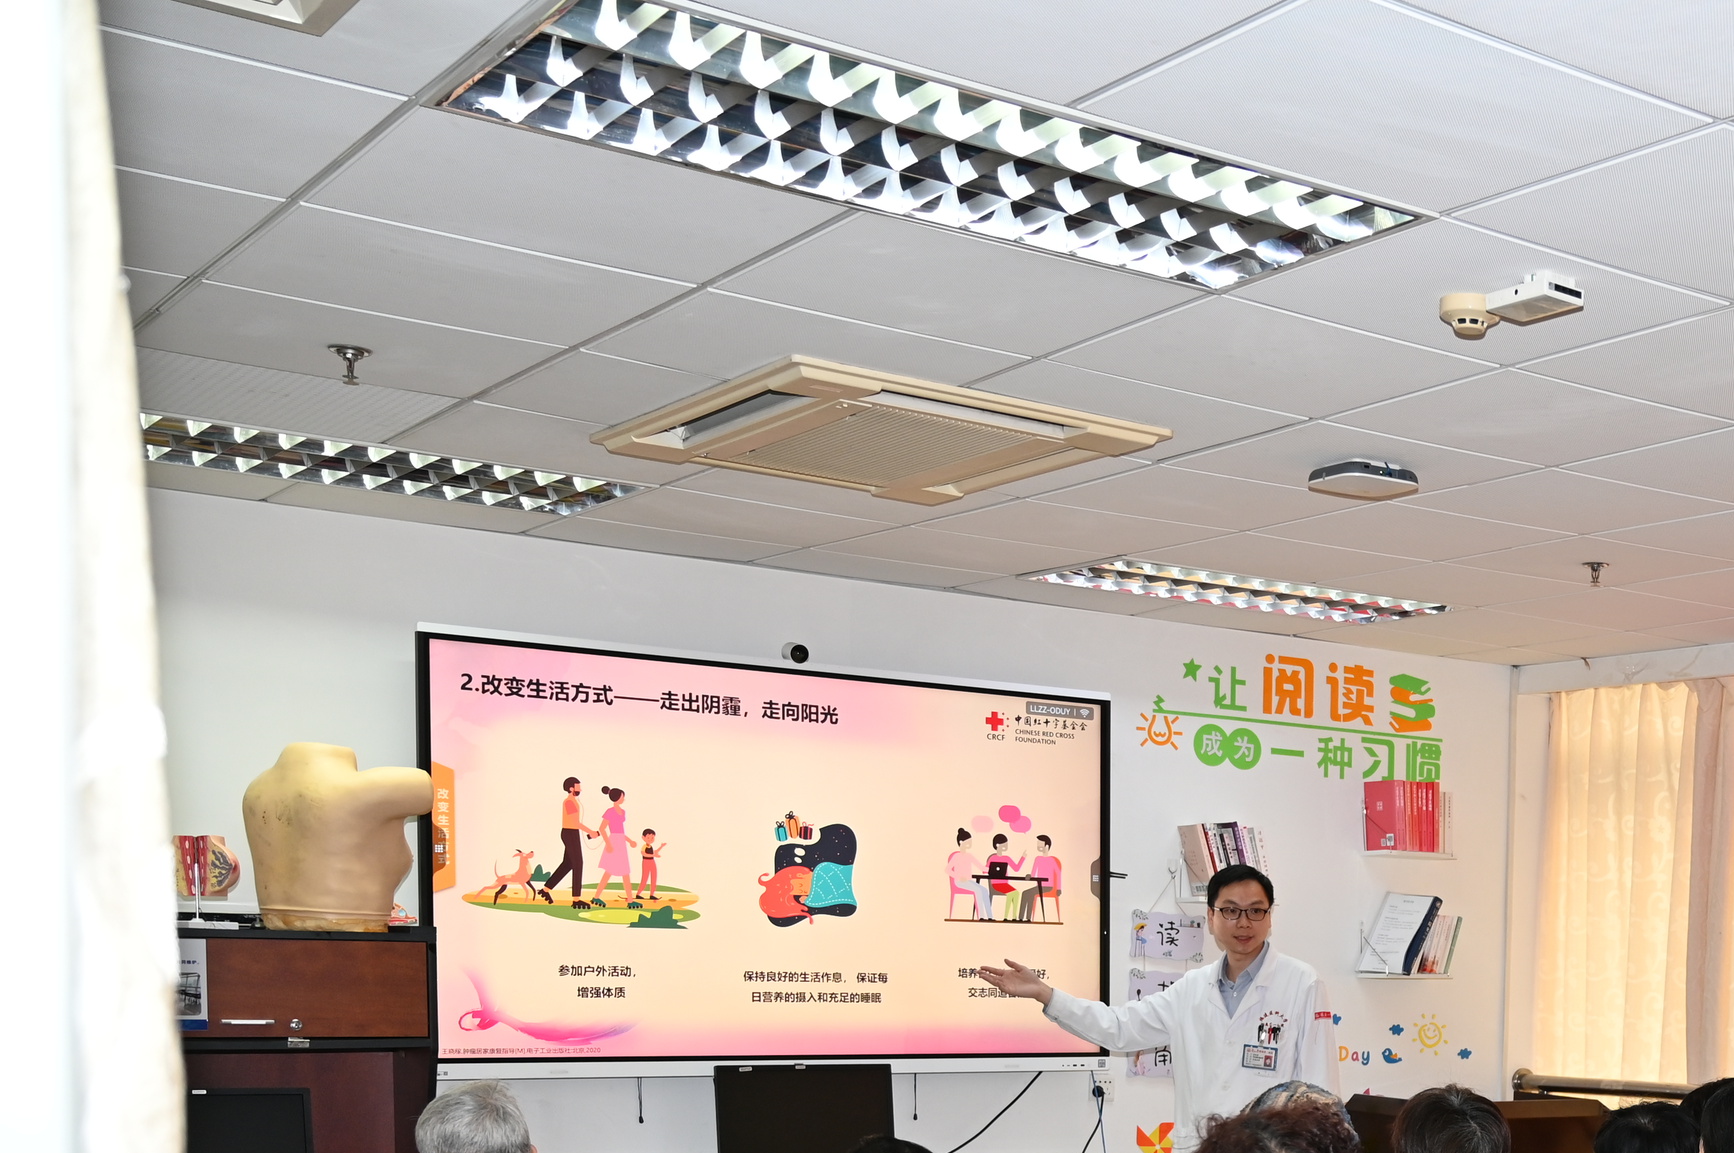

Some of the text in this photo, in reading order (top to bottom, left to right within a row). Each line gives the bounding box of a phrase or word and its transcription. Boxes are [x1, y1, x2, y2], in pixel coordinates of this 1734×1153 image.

[1209, 653, 1375, 726] 让阅读
[986, 733, 1006, 741] CRCF
[1014, 728, 1075, 740] CHINESE RED CROSS
[1014, 736, 1057, 745] FOUNDATION
[1201, 730, 1443, 782] 成为一种习惯
[577, 987, 626, 998] 增强体质
[751, 991, 882, 1004] 日营养的摄入和充足的睡眠
[1338, 1045, 1371, 1066] Day
